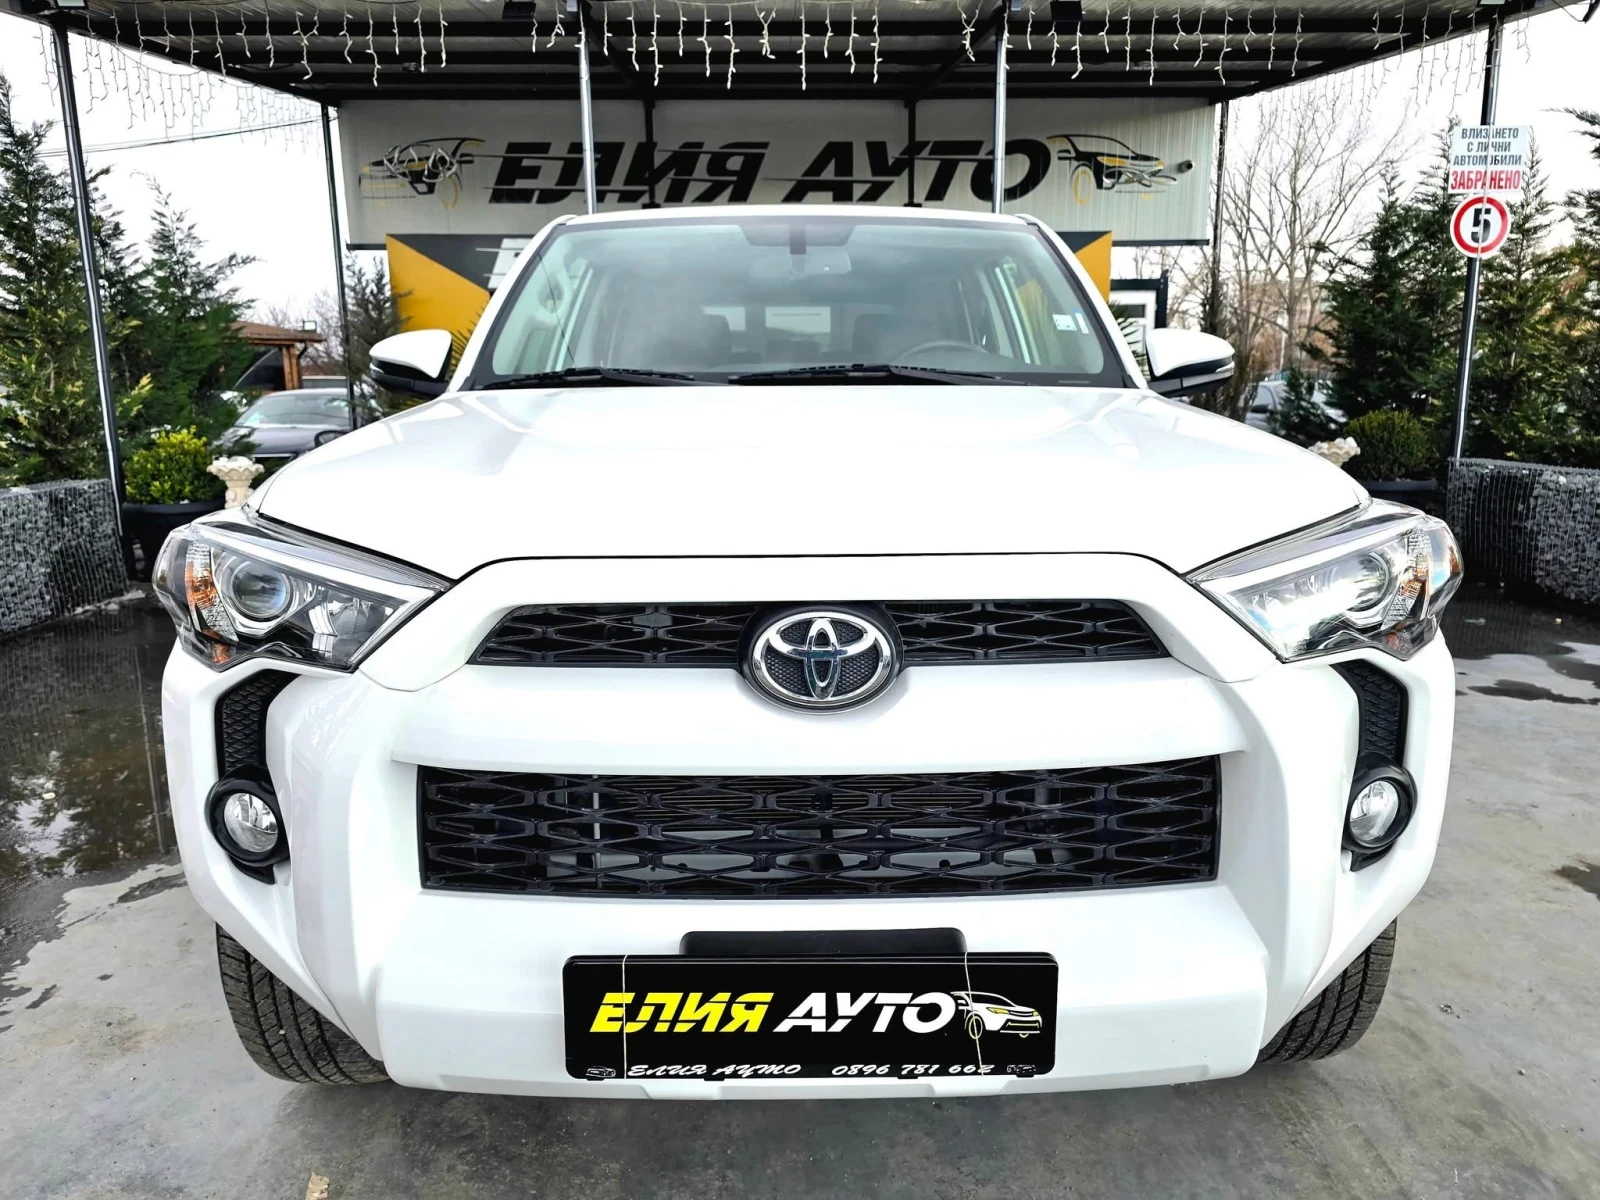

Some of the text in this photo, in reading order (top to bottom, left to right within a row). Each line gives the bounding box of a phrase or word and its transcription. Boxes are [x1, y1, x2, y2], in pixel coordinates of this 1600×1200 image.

[1467, 141, 1511, 152] С ЛИЧНИ
[488, 139, 1052, 204] ЕЛИЯ АУТО
[1450, 170, 1521, 190] ЗАБРАНЕНО
[1470, 208, 1491, 243] 5
[589, 992, 956, 1033] ЕЛИЯ АУТО
[832, 1064, 995, 1076] 0896 781 662
